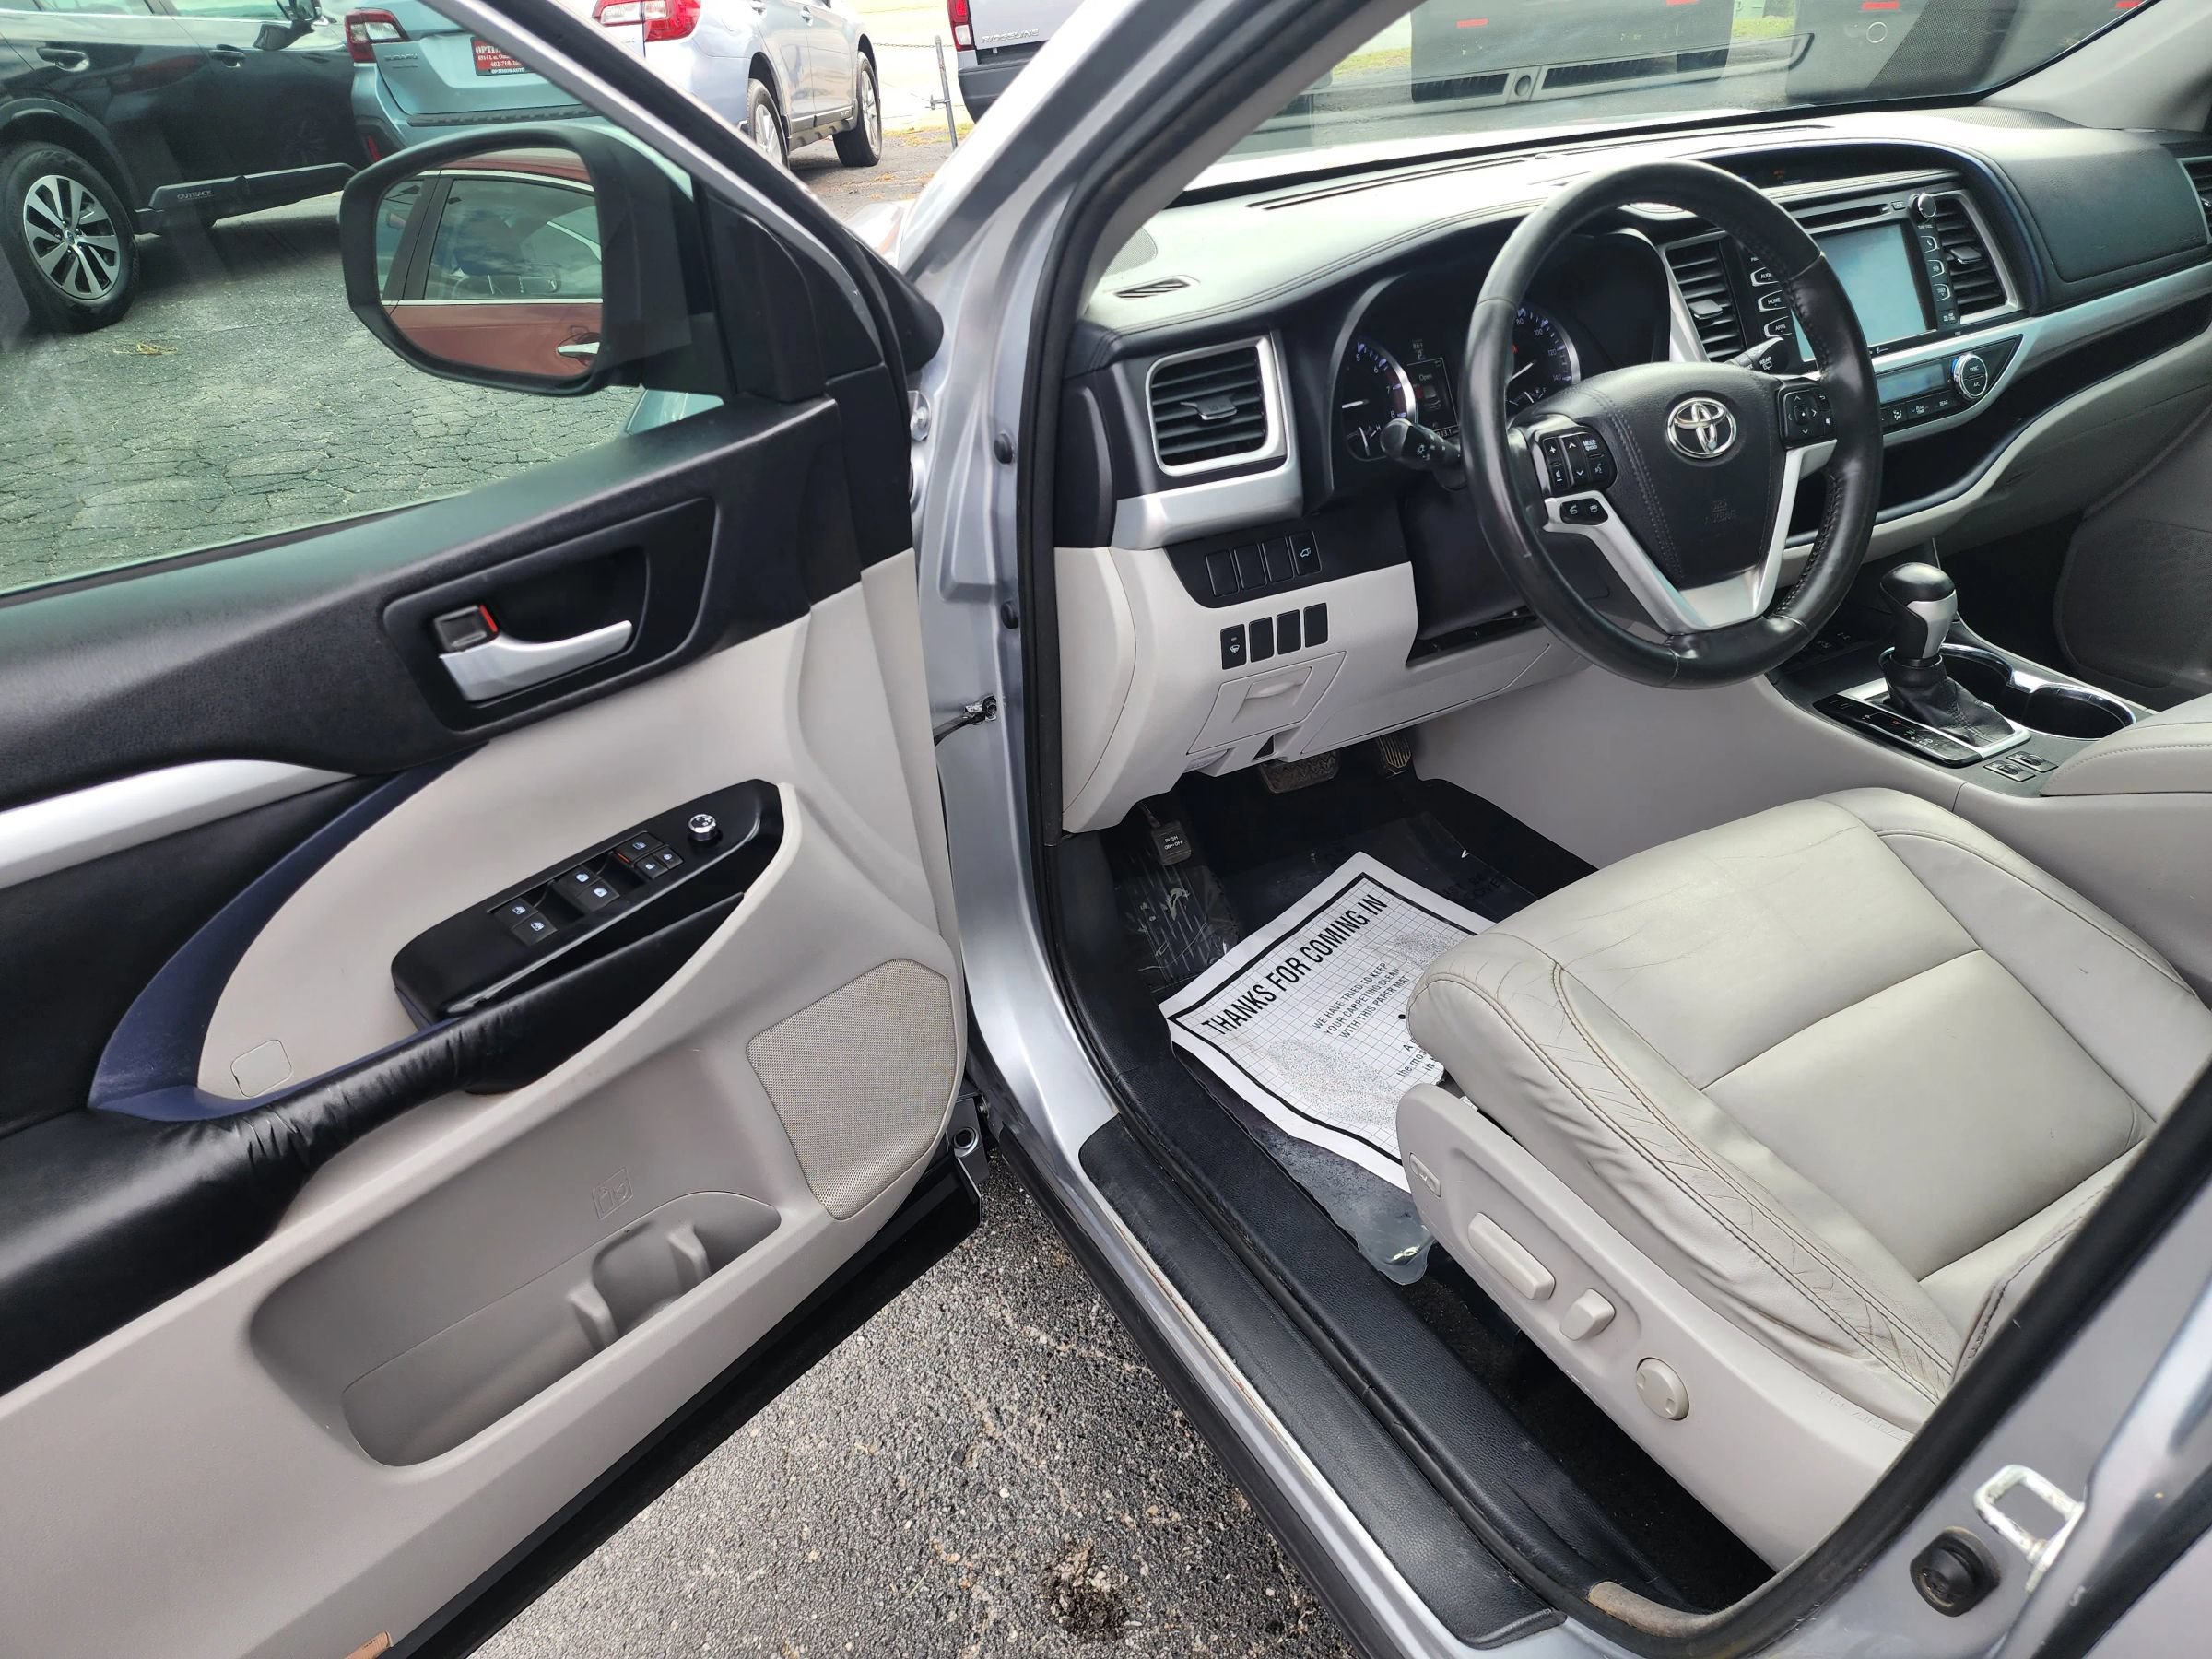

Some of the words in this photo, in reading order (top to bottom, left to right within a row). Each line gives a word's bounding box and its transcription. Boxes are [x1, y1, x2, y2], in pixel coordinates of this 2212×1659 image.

[982, 29, 1039, 43] RIDGELINE
[1356, 353, 1361, 362] 5
[1759, 356, 1772, 365] REAR
[1201, 984, 1277, 1035] THANKS
[1265, 957, 1312, 992] FOR
[1300, 910, 1371, 963] COMING
[1358, 894, 1388, 915] IN
[1312, 1017, 1328, 1029] WE
[1324, 1000, 1346, 1018] HAVE
[1340, 984, 1364, 1002] TRIED
[1359, 976, 1373, 985] TO
[1370, 962, 1388, 978] KEEP
[1324, 1017, 1347, 1035] YOUR
[1343, 983, 1382, 1018] CARPETING
[1377, 967, 1402, 986] CLEAN
[1339, 1019, 1361, 1039] WITH
[1357, 1005, 1377, 1021] THIS
[1372, 987, 1397, 1006] PAPER
[1393, 975, 1410, 988] MAT
[1396, 1065, 1413, 1077] the
[1409, 1050, 1428, 1067] mos
[1422, 1063, 1435, 1071] in
